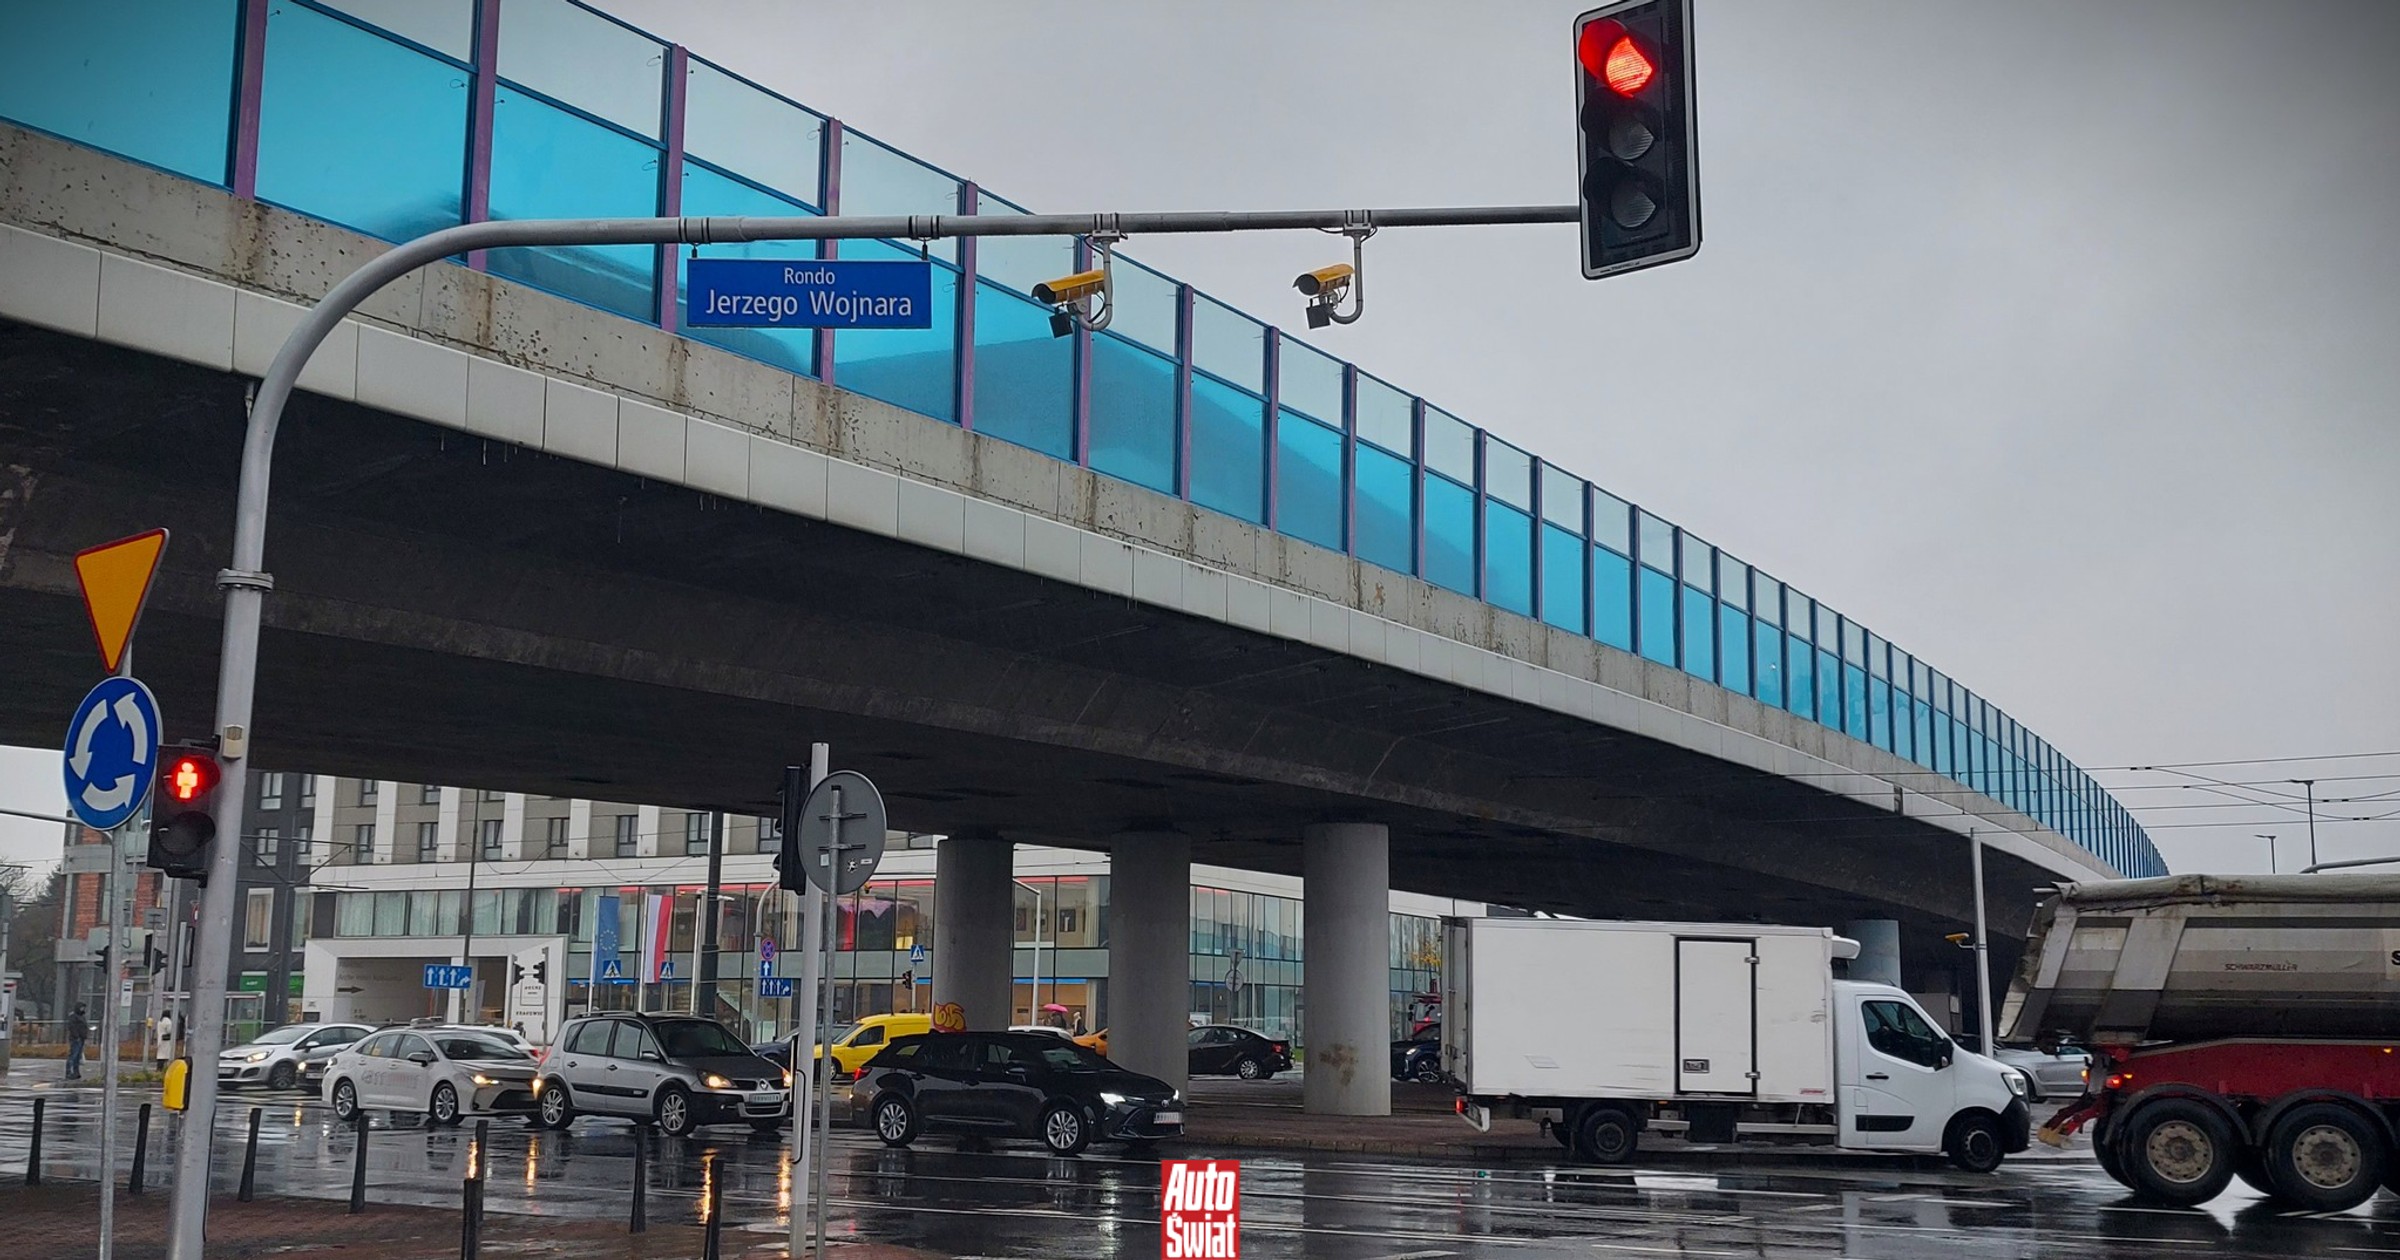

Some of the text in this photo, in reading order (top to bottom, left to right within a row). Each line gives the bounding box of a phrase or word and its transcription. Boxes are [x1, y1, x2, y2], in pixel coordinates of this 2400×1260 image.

[784, 267, 836, 285] Rondo
[706, 289, 912, 323] Jerzego Wojnara
